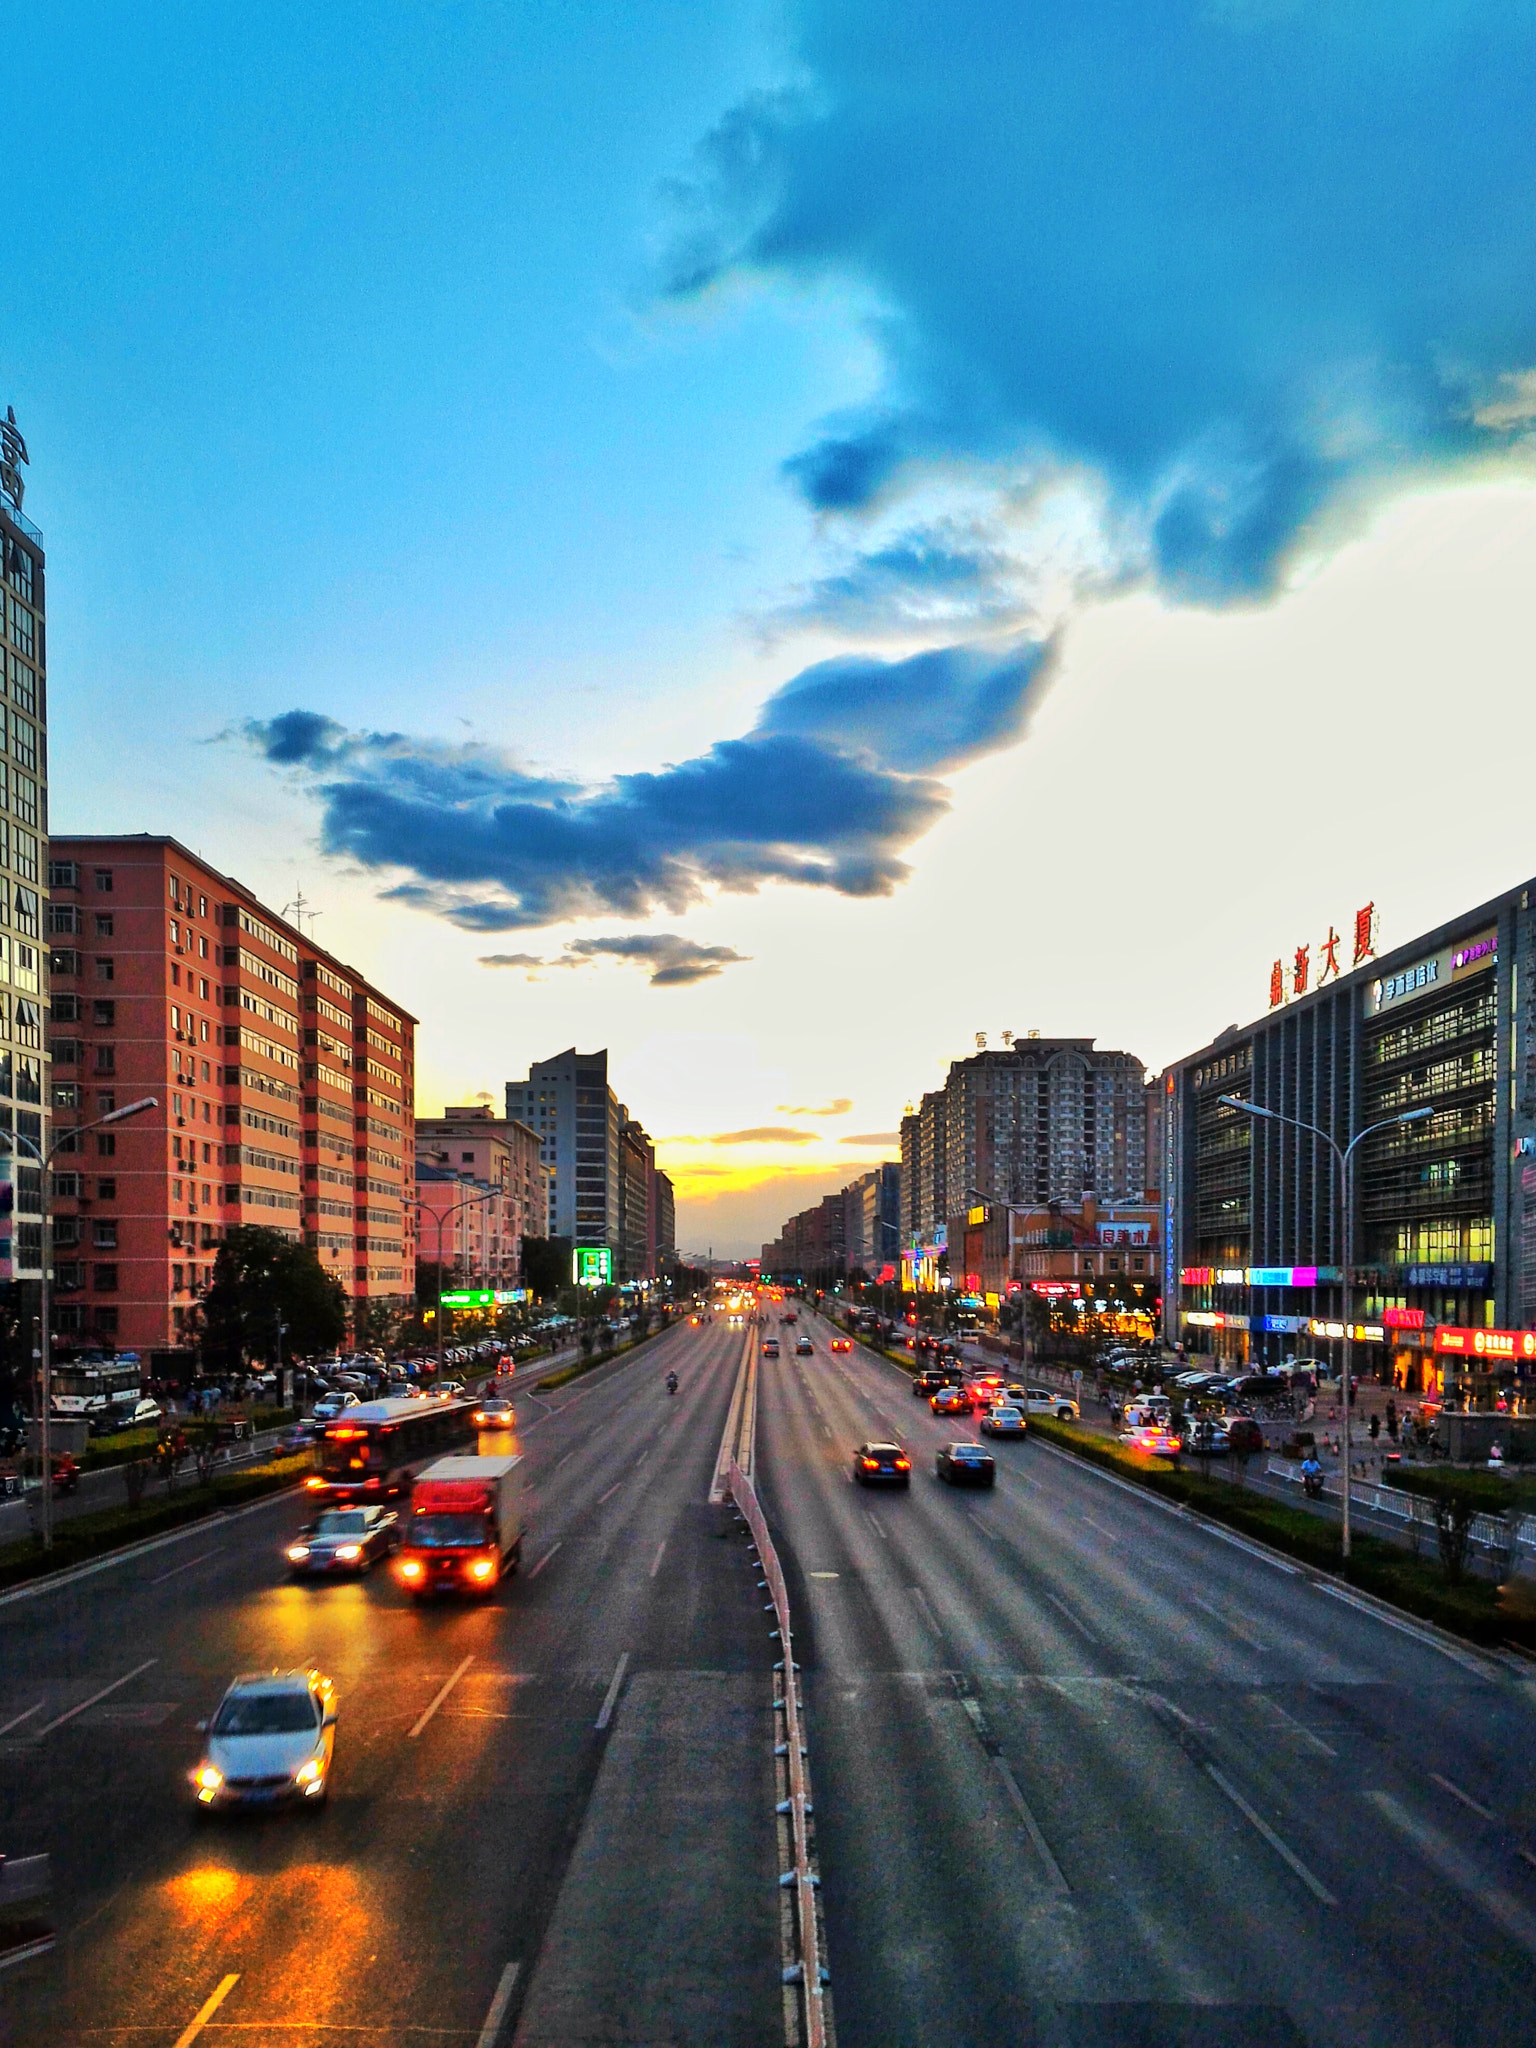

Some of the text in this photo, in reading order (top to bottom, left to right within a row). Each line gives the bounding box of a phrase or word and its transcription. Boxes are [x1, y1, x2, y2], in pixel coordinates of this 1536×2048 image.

[1385, 959, 1439, 1000] 学而思培优
